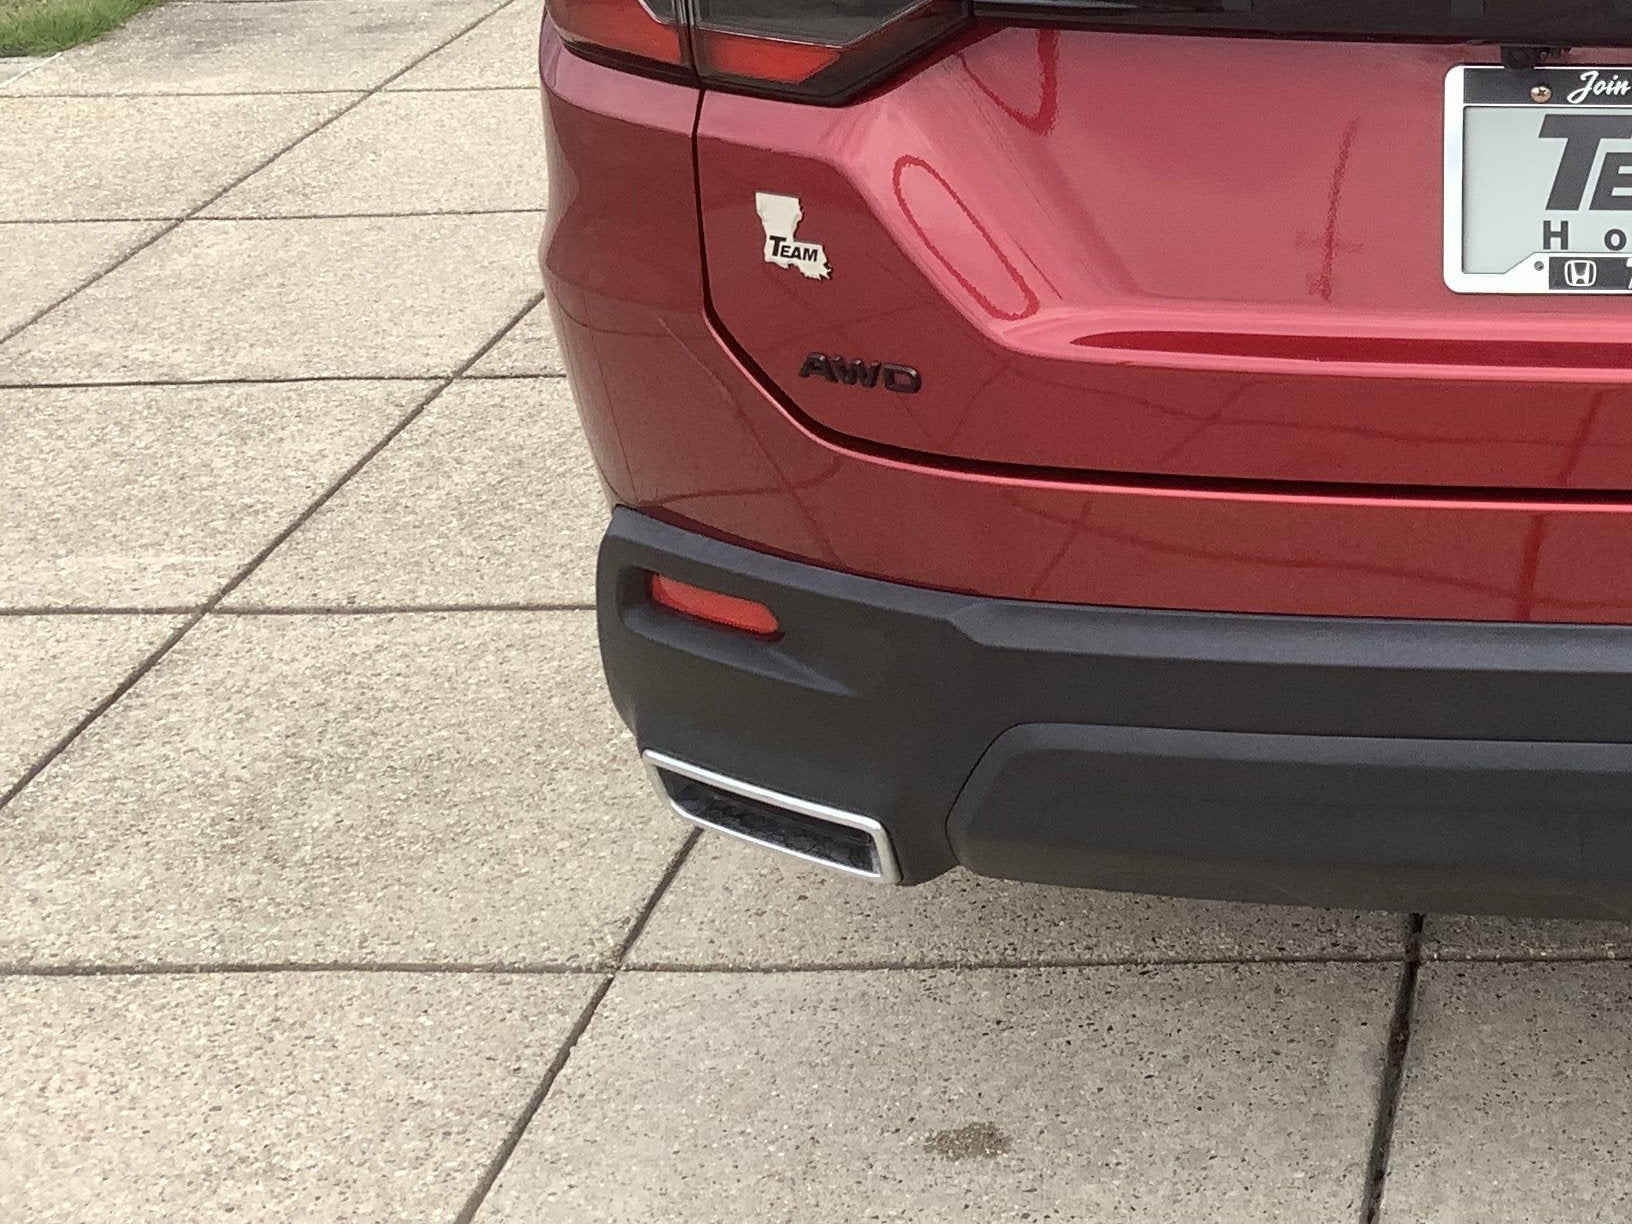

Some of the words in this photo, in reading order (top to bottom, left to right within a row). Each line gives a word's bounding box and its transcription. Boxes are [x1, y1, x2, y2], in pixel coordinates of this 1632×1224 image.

[1567, 71, 1631, 104] Join
[769, 235, 818, 262] TEAM
[799, 352, 922, 394] AWD
